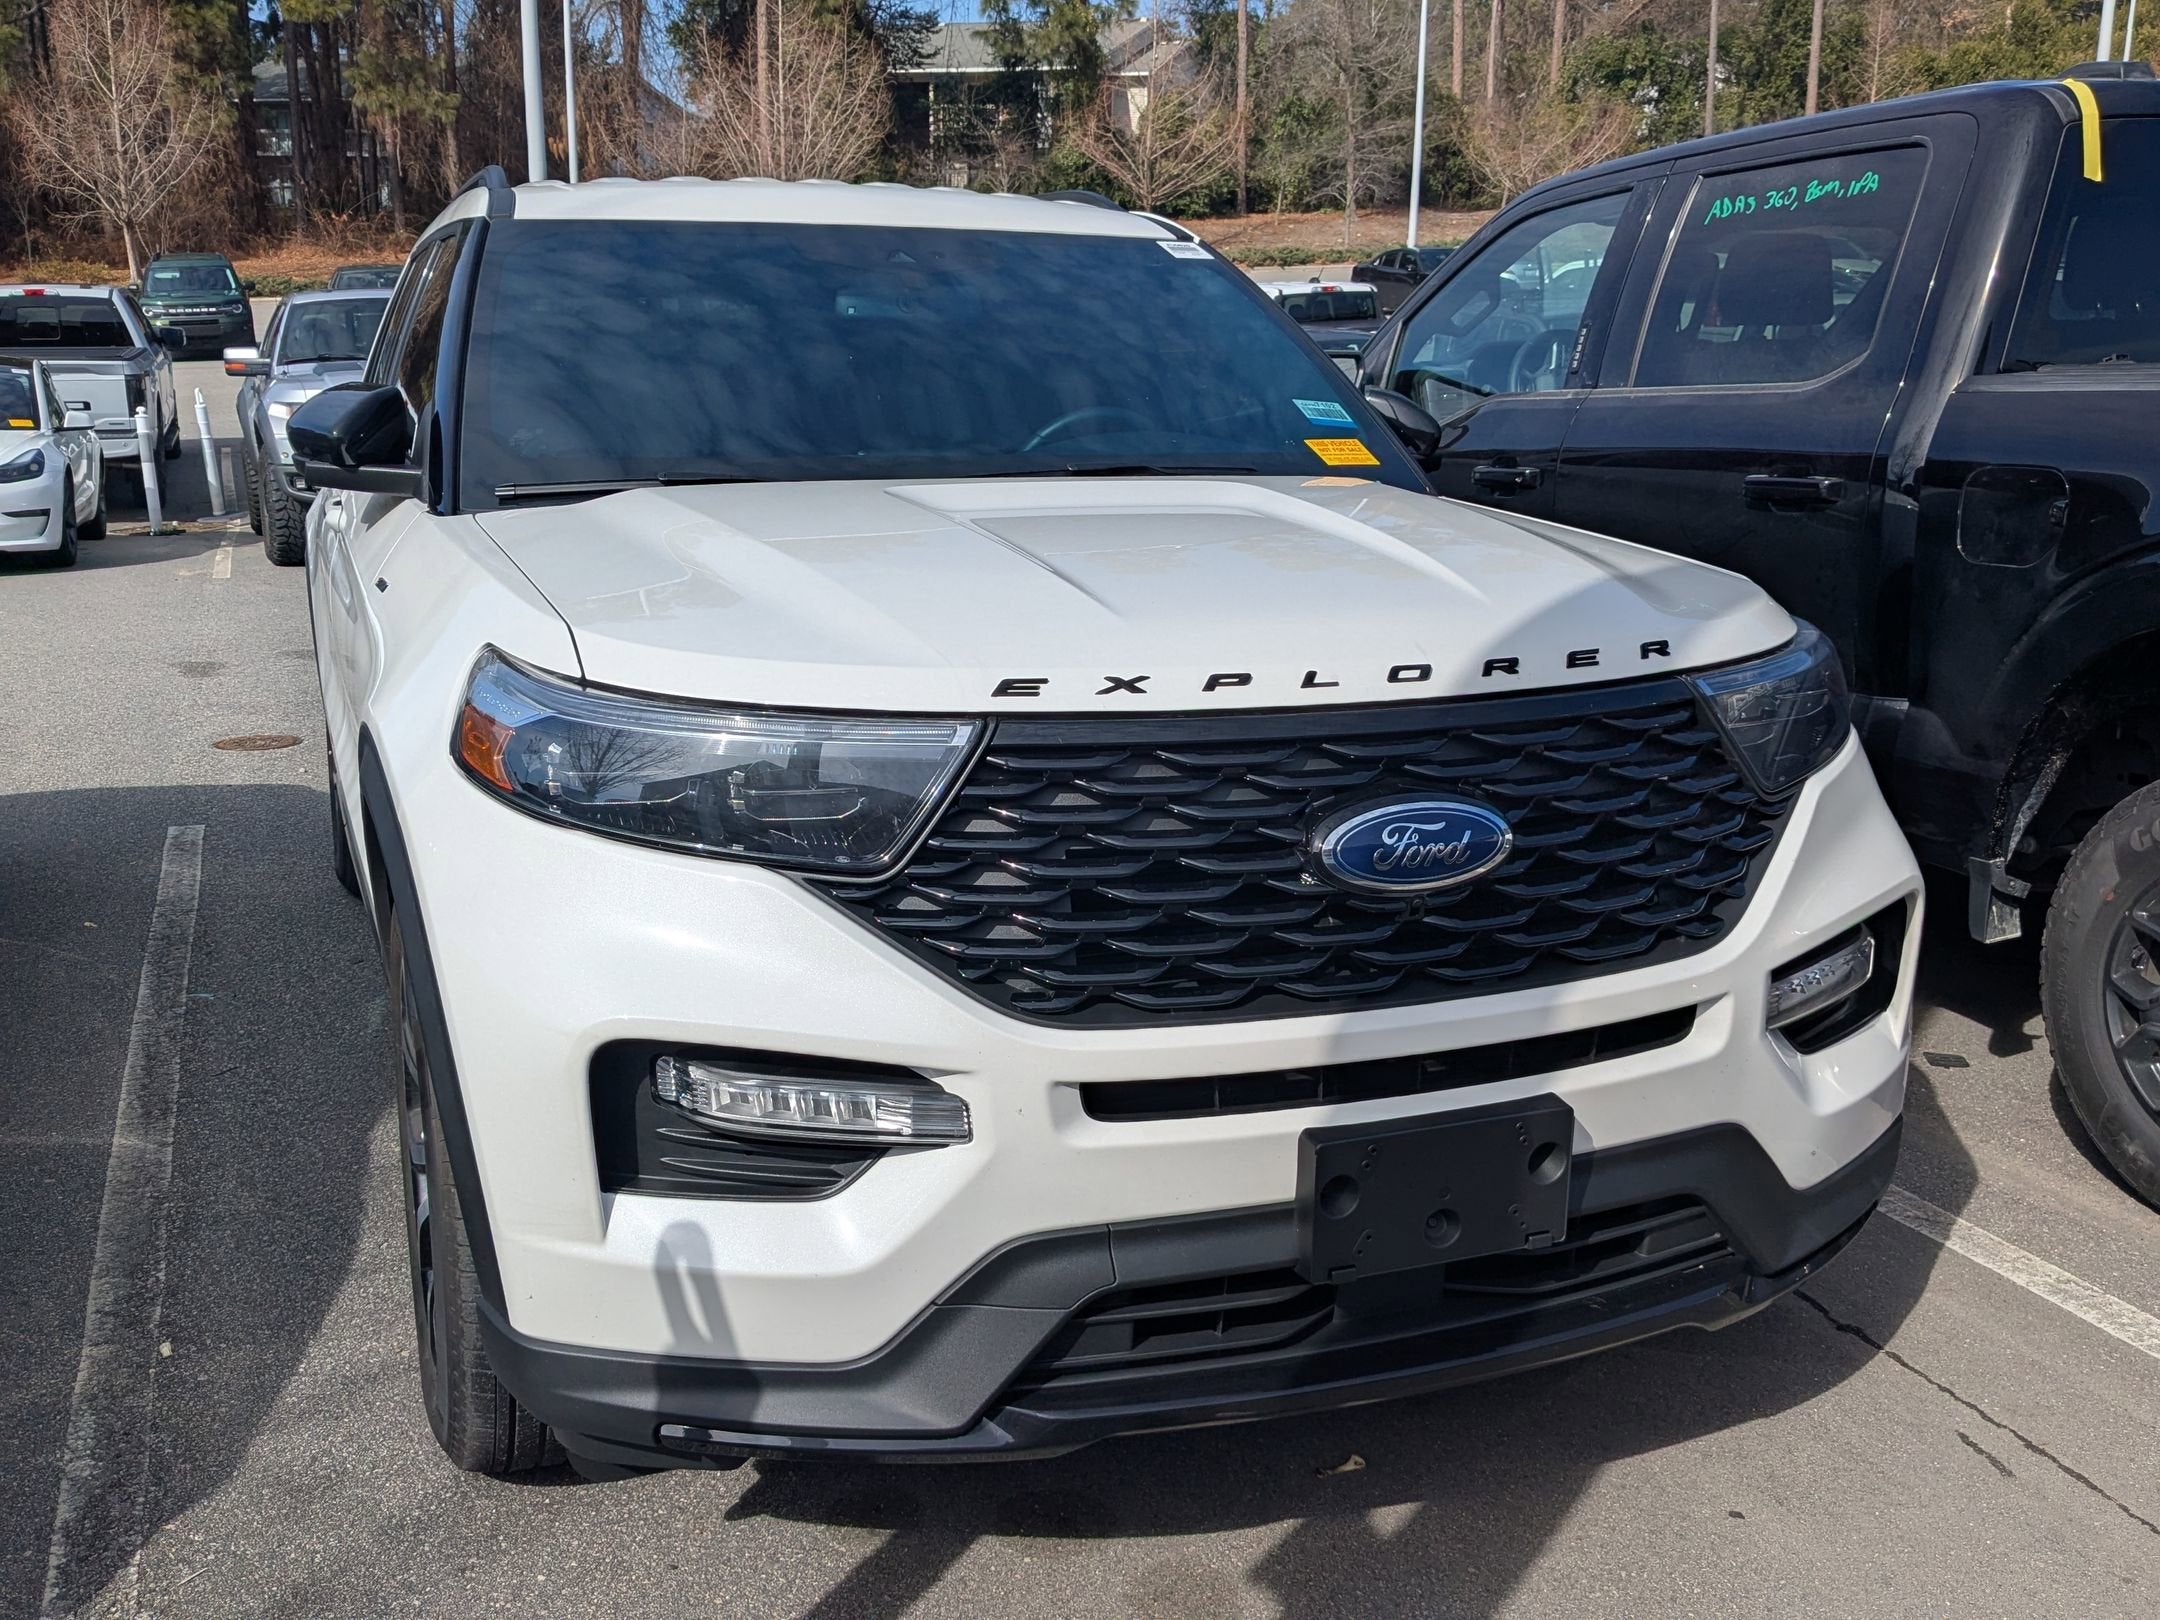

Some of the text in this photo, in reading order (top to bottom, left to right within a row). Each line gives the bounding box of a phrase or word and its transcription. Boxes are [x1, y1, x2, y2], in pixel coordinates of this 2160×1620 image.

[1704, 195, 1757, 225] ADAS
[1763, 186, 1799, 211] 360,
[990, 639, 1671, 697] EXPLORER
[1373, 820, 1472, 871] Ford
